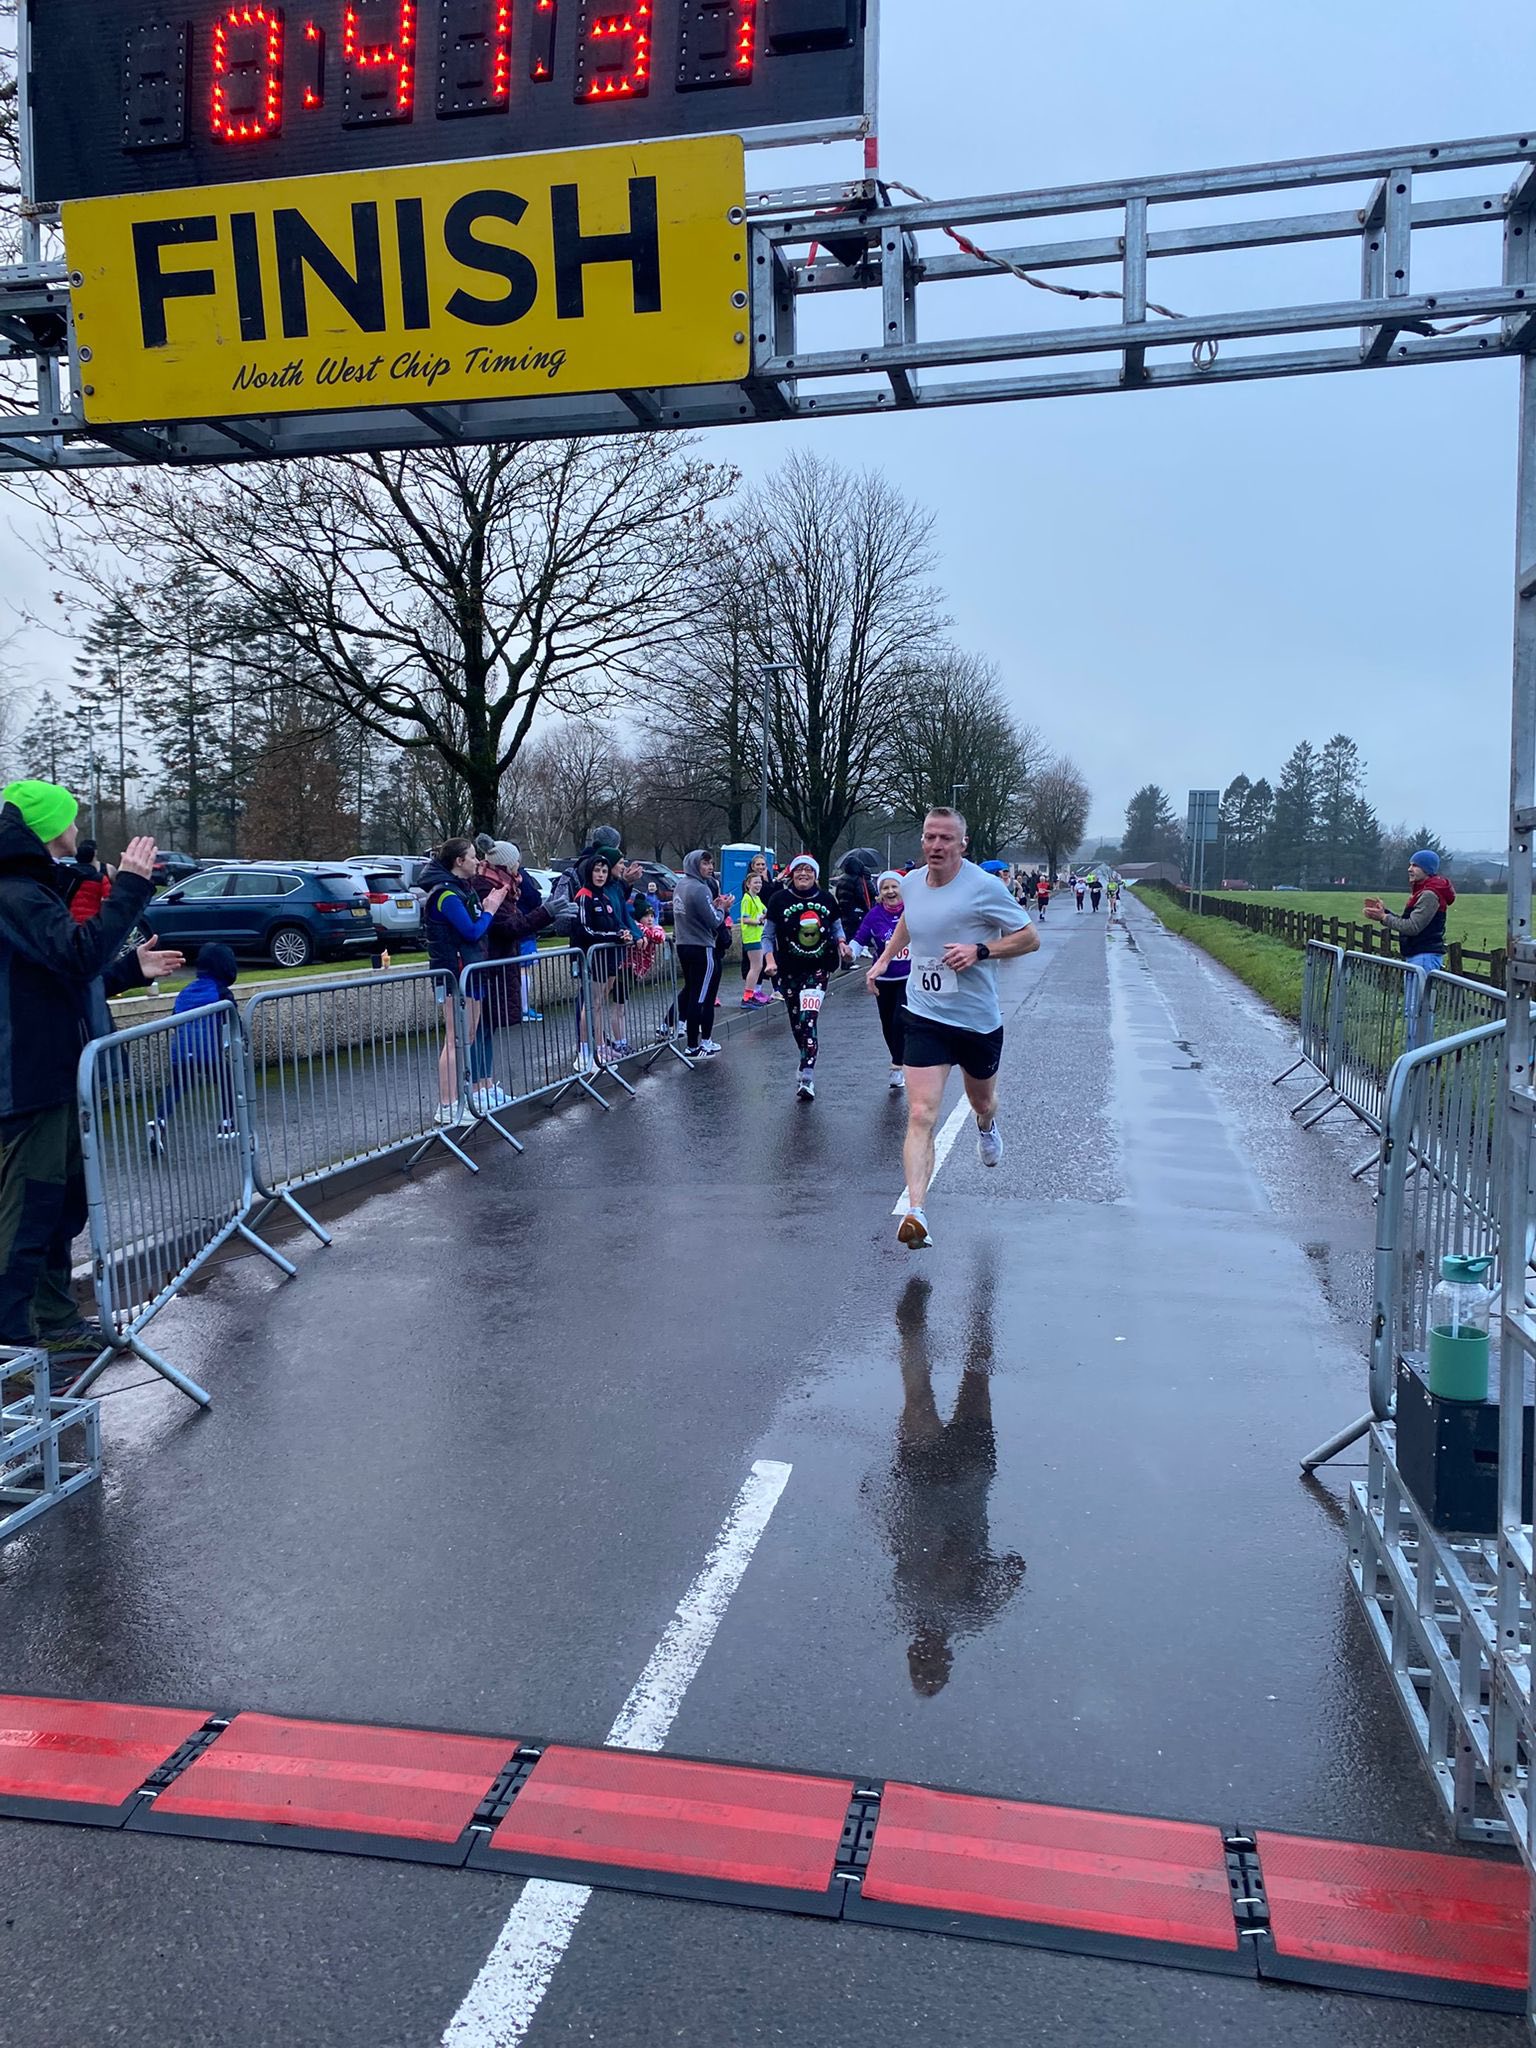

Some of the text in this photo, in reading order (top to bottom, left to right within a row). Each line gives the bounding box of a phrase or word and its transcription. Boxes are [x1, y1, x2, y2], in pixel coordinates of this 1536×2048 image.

[131, 175, 662, 348] FINISH
[232, 346, 567, 390] North West Chip Timing
[921, 972, 942, 992] 60
[802, 997, 821, 1010] 800
